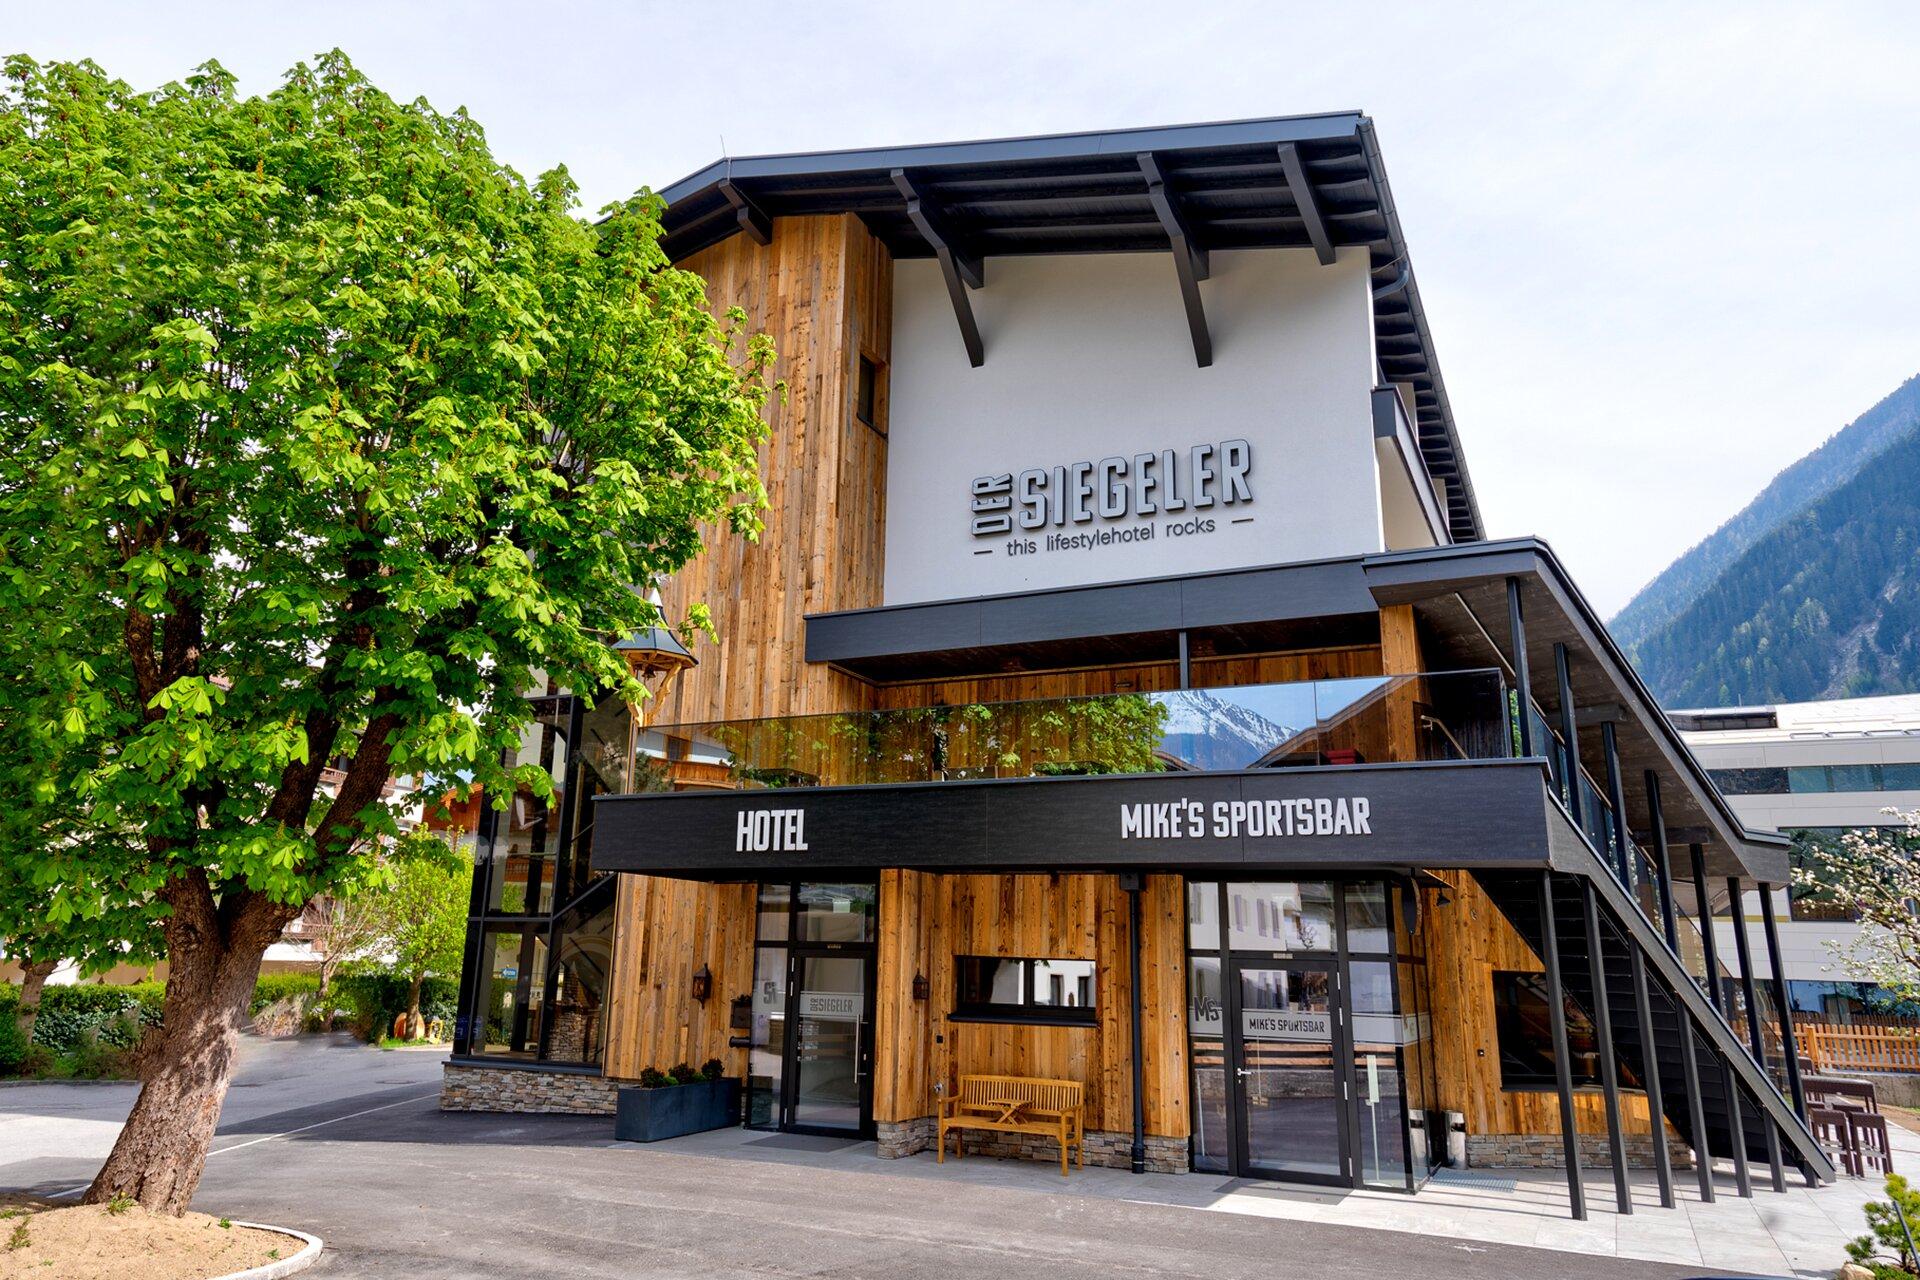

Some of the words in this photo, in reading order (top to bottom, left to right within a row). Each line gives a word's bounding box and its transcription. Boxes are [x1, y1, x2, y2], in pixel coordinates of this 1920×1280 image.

[971, 472, 1012, 537] DER
[1019, 438, 1254, 530] SIEGELER
[1006, 538, 1037, 557] this
[1046, 522, 1155, 552] lifestylehotel
[1166, 516, 1216, 538] rocks
[736, 808, 808, 852] HOTEL
[1121, 797, 1205, 839] MIKE'S
[1213, 797, 1372, 838] SPORTSBAR
[818, 998, 853, 1013] SIEGELER
[1249, 1017, 1276, 1031] MIKE'S
[1278, 1019, 1325, 1033] SPORTSBAR
